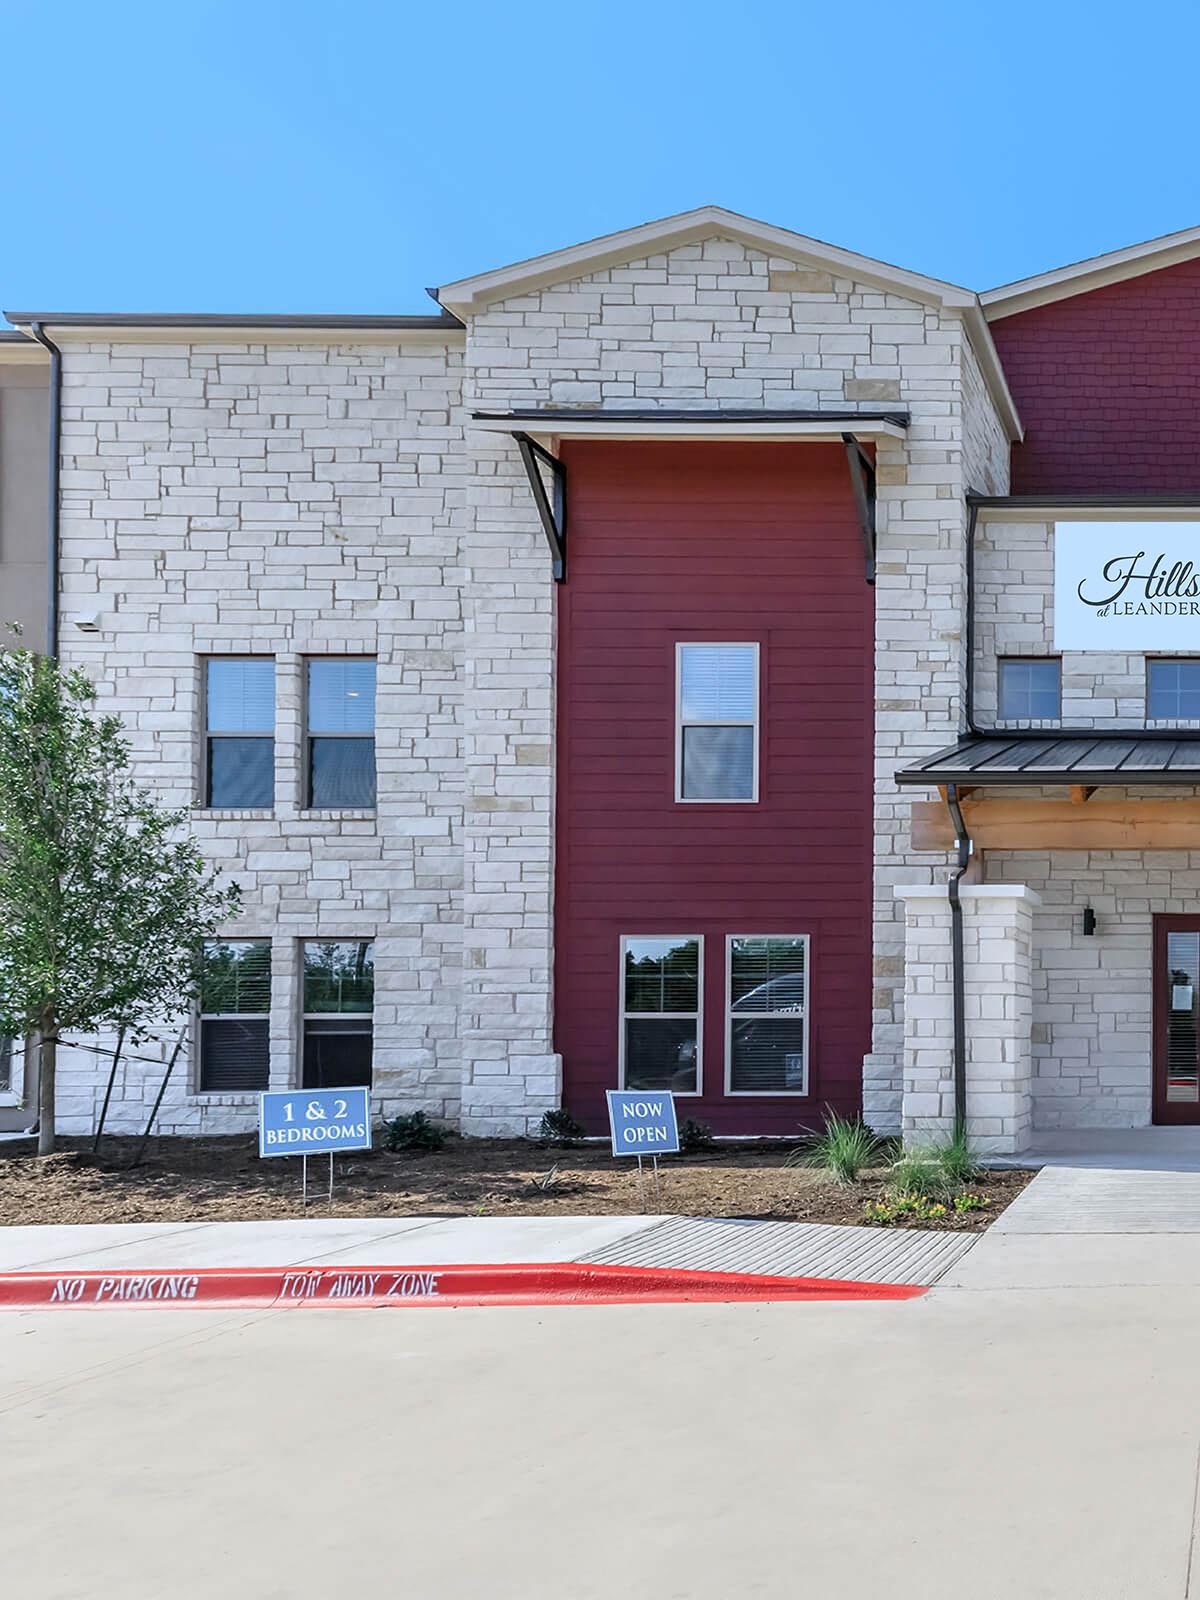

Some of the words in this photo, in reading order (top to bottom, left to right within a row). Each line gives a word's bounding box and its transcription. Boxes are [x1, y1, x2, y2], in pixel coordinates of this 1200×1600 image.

[1096, 604, 1110, 617] at
[1113, 601, 1200, 616] LEANDER
[282, 1102, 295, 1122] 1
[305, 1101, 328, 1120] &
[334, 1099, 348, 1119] 2
[622, 1102, 662, 1118] NOW
[266, 1123, 365, 1145] BEDROOMS
[623, 1126, 667, 1143] OPEN
[50, 1279, 86, 1302] NO
[95, 1276, 199, 1301] PARKING
[278, 1272, 322, 1297] TOW
[328, 1272, 379, 1297] AWAY
[386, 1271, 443, 1297] ZONE
